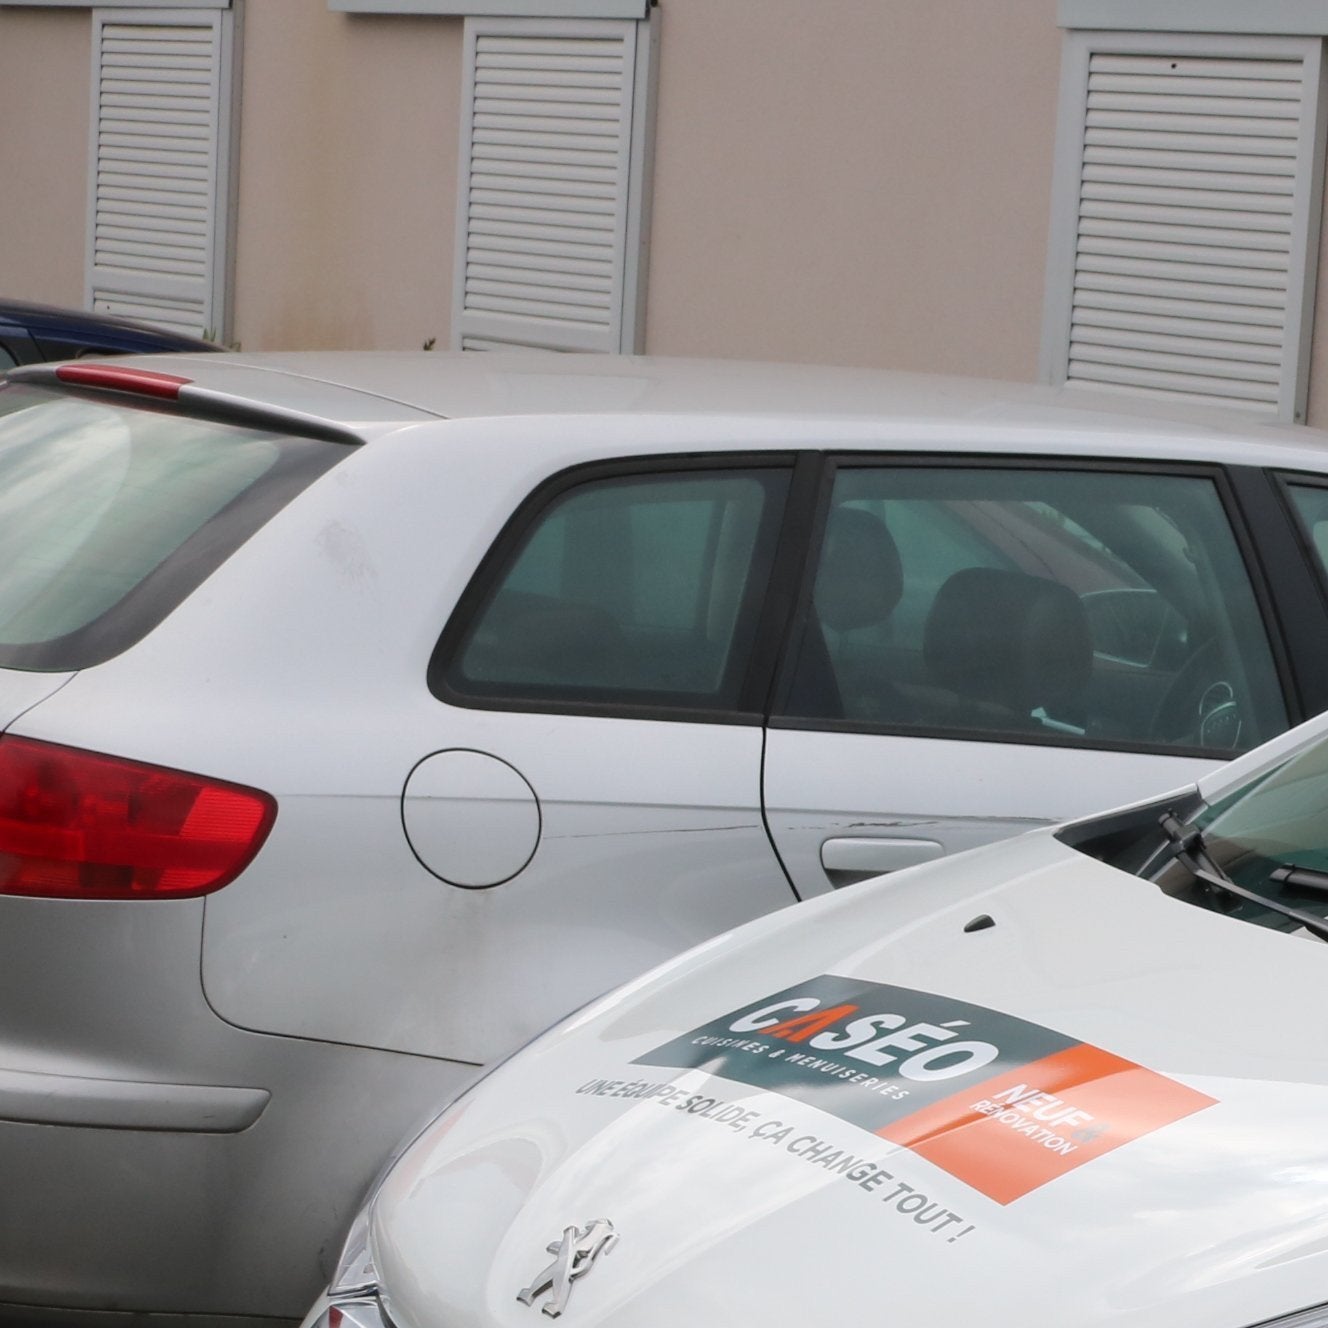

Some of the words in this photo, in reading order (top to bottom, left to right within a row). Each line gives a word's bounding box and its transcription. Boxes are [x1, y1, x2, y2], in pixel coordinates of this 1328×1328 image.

[692, 1035, 769, 1055] CUISINES
[785, 1051, 910, 1101] MENUISERIES
[728, 997, 999, 1082] CASÉO
[992, 1083, 1095, 1127] NEUF
[575, 1080, 616, 1097] UNE
[675, 1094, 761, 1132] SOLIDE,
[748, 1119, 795, 1145] ÇA
[786, 1134, 894, 1192] CHANGE
[882, 1181, 963, 1234] TOUT
